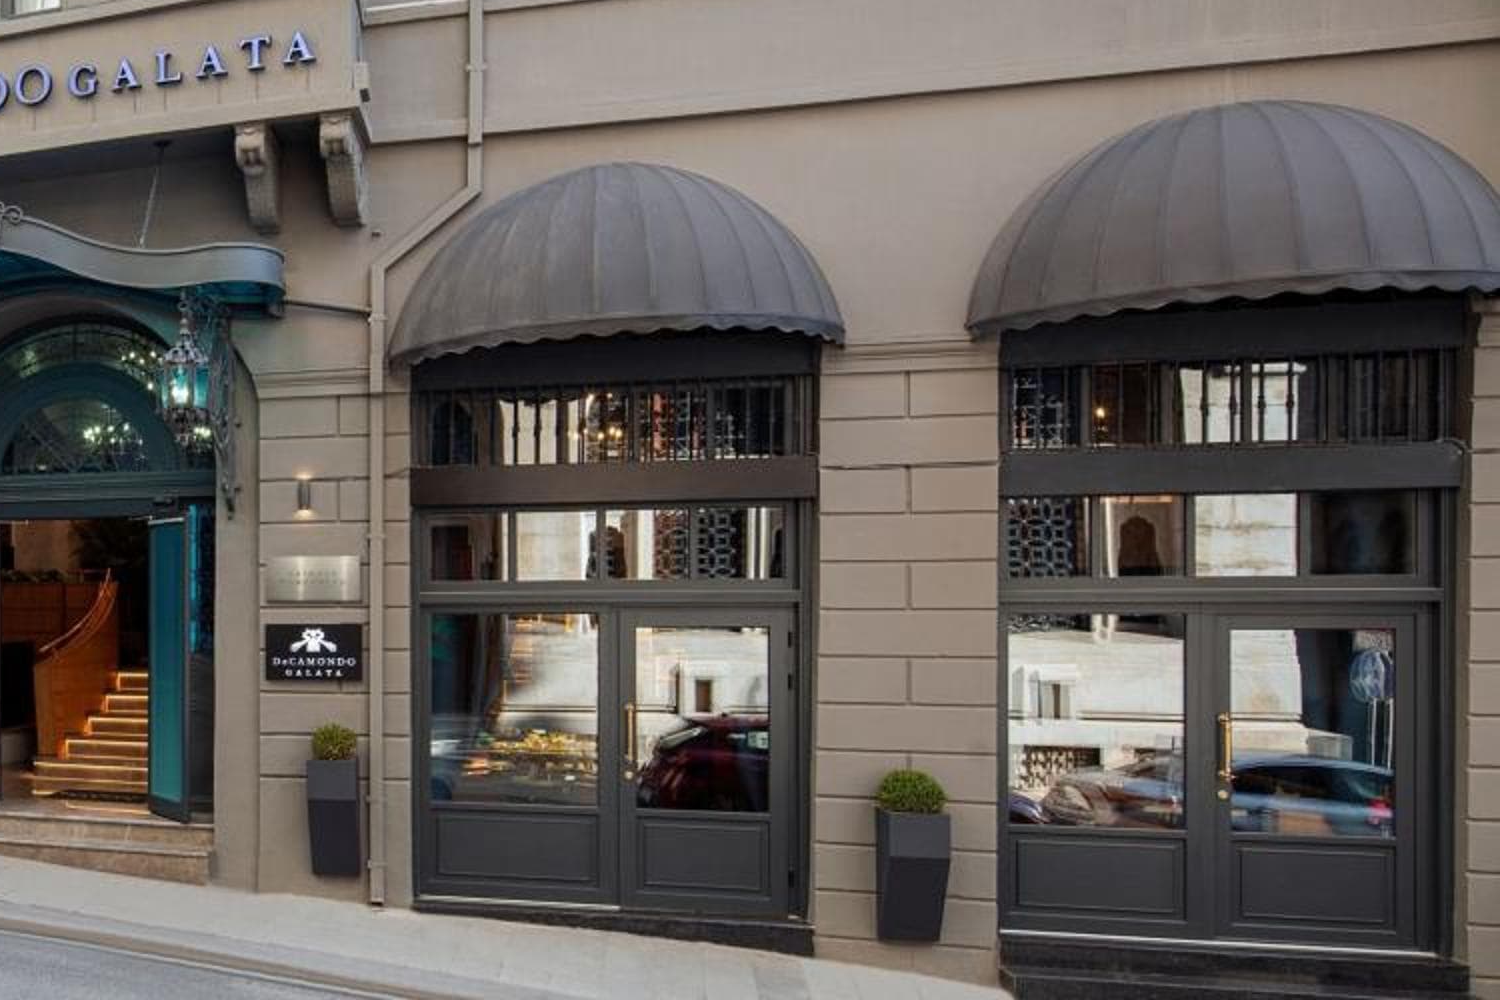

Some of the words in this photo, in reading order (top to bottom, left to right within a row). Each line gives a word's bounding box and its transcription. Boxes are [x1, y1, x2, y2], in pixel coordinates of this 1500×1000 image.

[68, 31, 317, 98] GALATA
[273, 657, 356, 667] DeCAMONDO
[285, 669, 343, 677] GALATA
